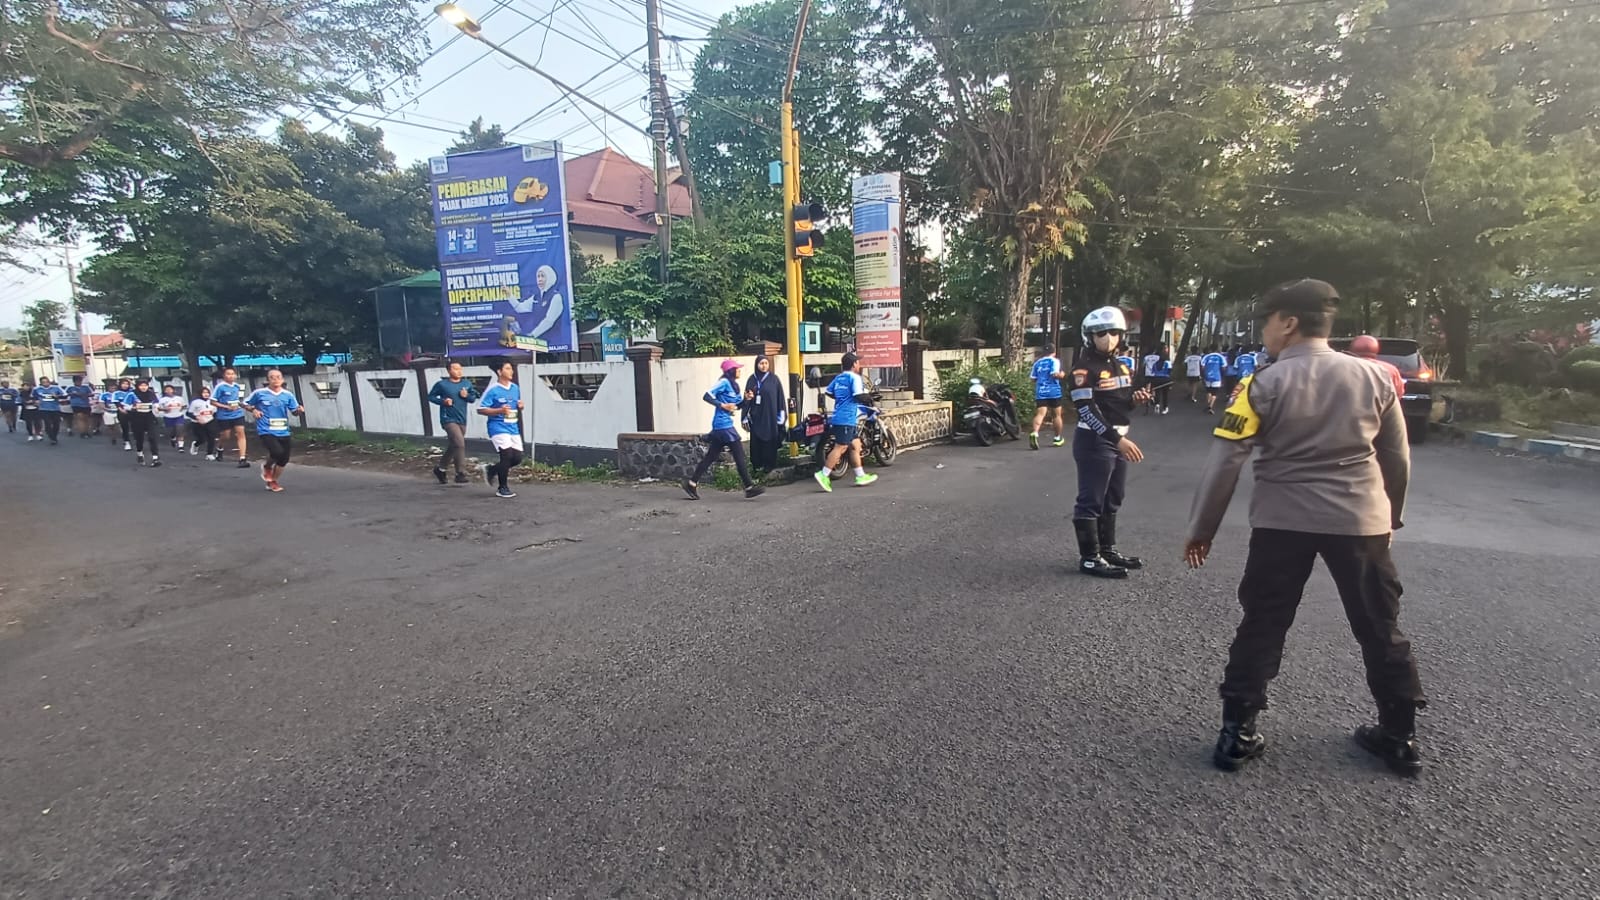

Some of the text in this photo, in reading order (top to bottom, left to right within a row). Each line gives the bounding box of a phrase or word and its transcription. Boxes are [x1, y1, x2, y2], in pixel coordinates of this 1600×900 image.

[440, 199, 460, 211] PAJAK
[489, 193, 508, 206] 2025
[448, 230, 456, 241] 14
[465, 228, 474, 240] 31
[447, 276, 466, 290] PKB
[466, 274, 486, 288] DAN
[1078, 405, 1107, 435] DISHUB
